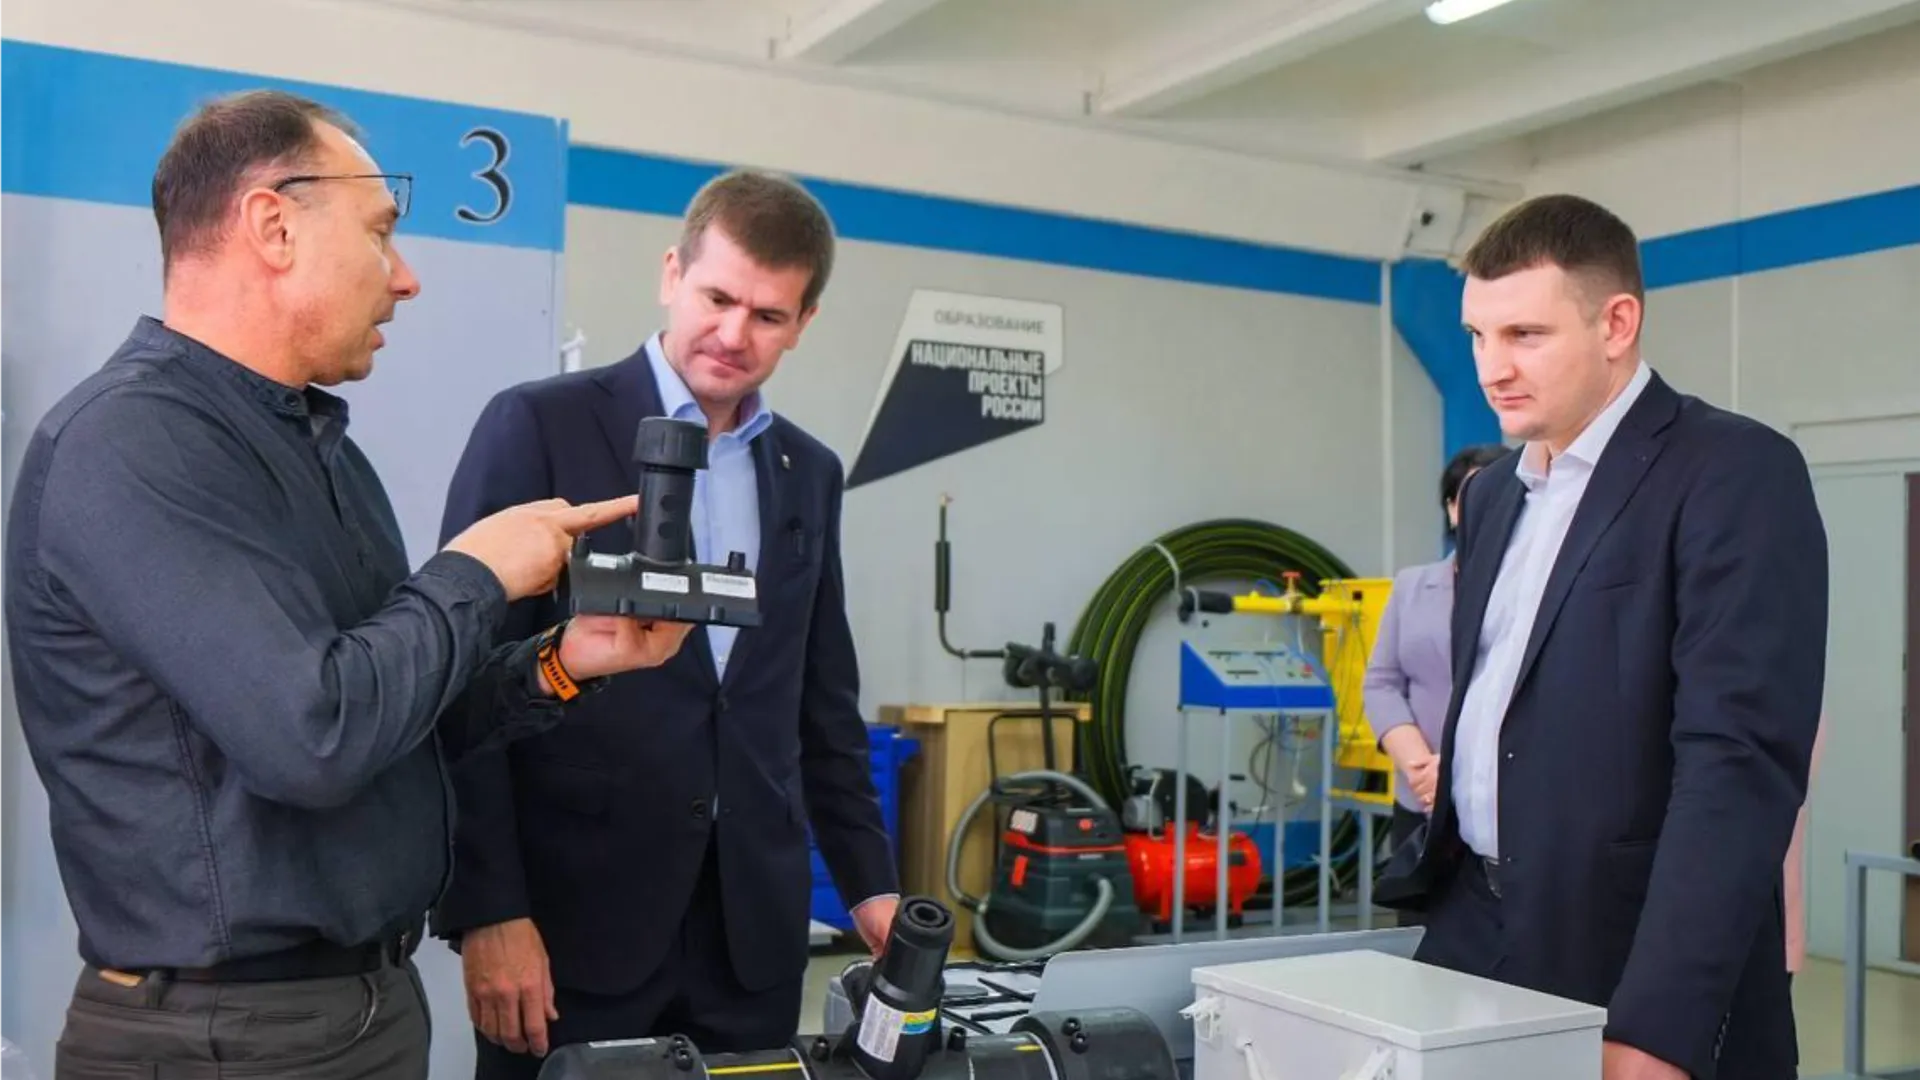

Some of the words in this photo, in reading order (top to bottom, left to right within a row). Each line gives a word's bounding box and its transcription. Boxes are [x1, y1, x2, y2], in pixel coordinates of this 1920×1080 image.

[457, 129, 511, 223] 3
[934, 309, 1044, 333] ОБРАЗОВАНИЕ
[911, 342, 1043, 373] НАЦИОНАЛЬНЫЕ
[968, 371, 1042, 398] ПРОЕКТЫ
[981, 395, 1042, 421] РОССИИ
